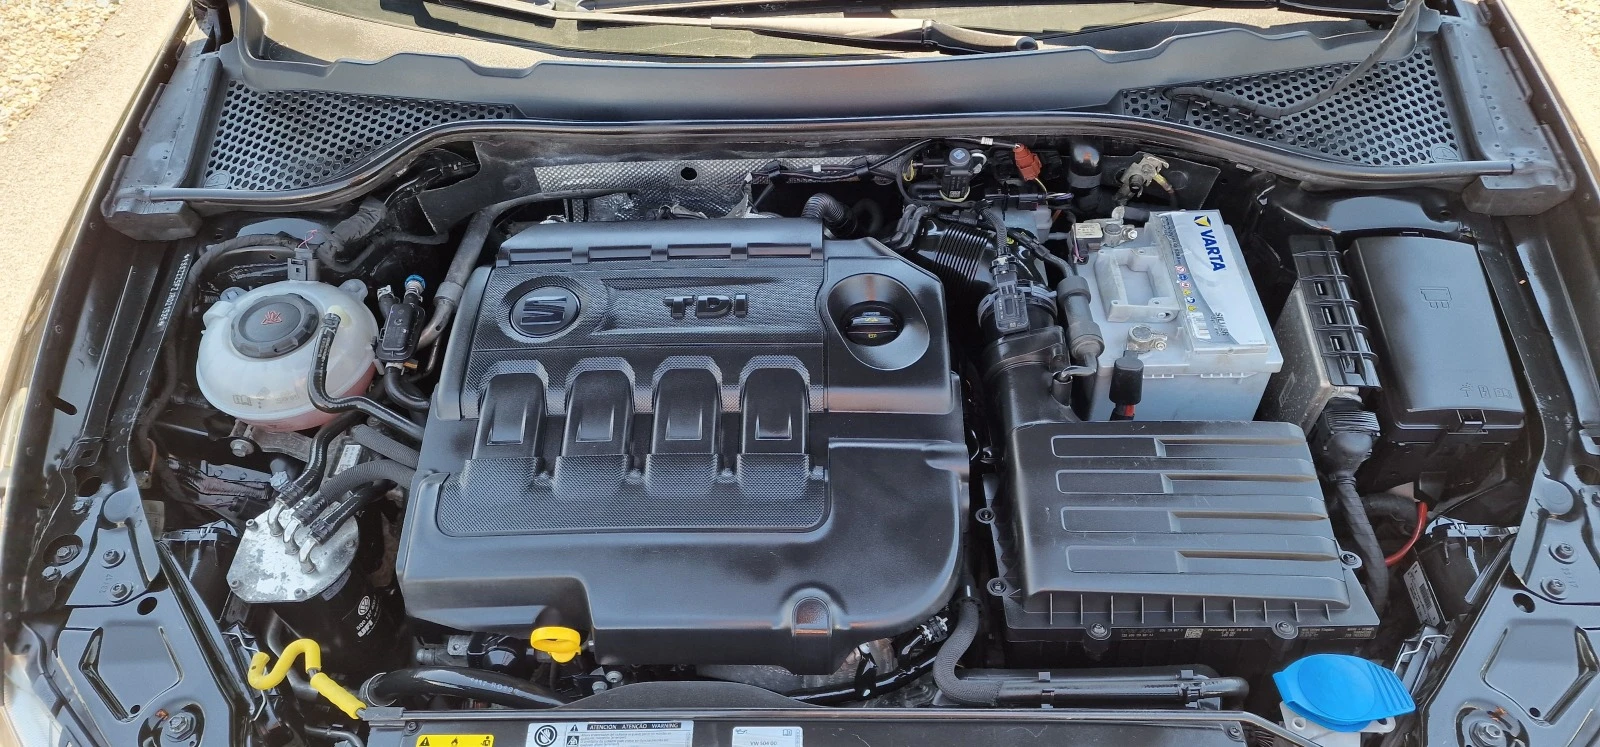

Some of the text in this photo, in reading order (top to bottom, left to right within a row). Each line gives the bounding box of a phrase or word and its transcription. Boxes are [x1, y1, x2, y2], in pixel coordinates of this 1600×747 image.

[1200, 229, 1226, 271] VARTA
[663, 293, 748, 319] TDI
[357, 619, 373, 638] UFI
